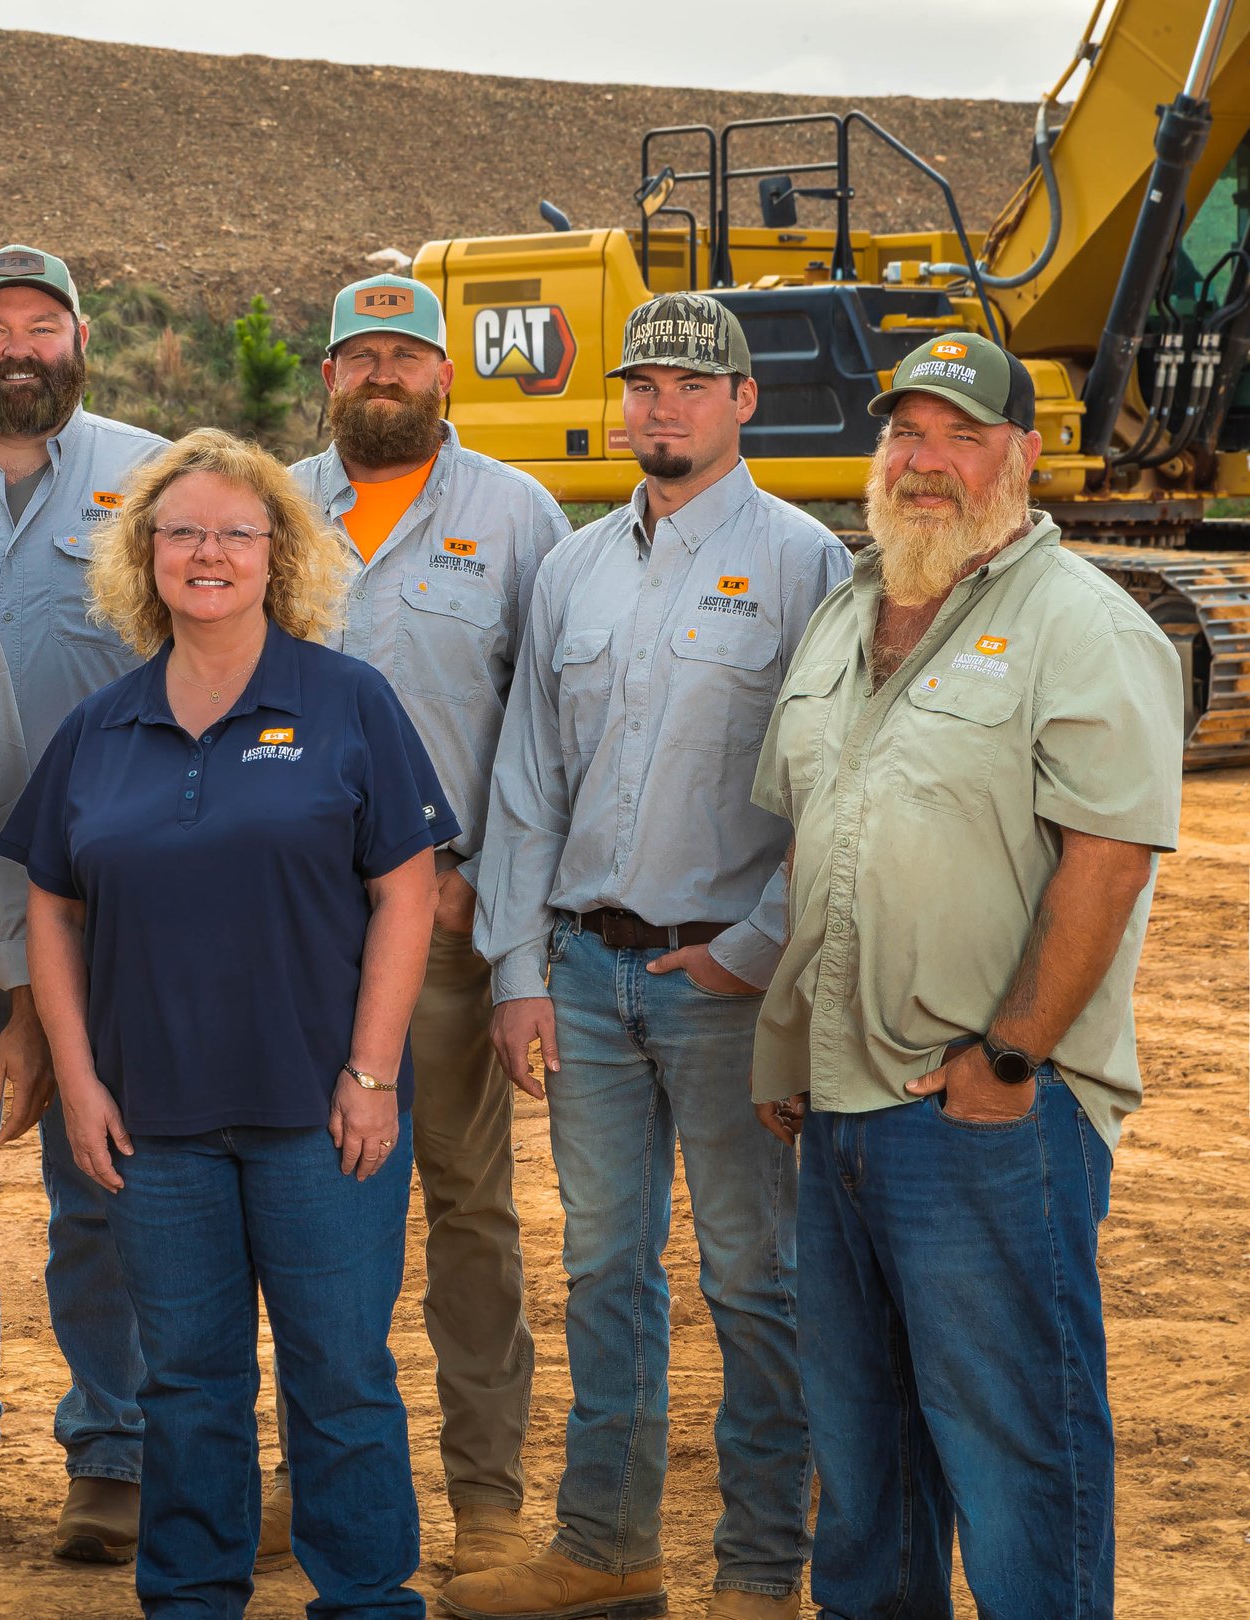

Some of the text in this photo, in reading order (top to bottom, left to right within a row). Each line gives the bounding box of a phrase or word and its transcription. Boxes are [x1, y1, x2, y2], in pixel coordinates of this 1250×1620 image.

[365, 294, 406, 306] LT
[632, 320, 715, 341] LASSITER TAYLOR
[475, 307, 551, 376] CAT
[631, 335, 716, 349] CONSTRUCTION
[935, 345, 962, 355] LT
[911, 361, 977, 379] LASSITER TAYLOR
[910, 370, 974, 385] CONSTRUCTION
[81, 508, 113, 519] LASSITER
[449, 542, 472, 552] LT
[429, 563, 484, 578] CONSTRUCTION
[430, 554, 486, 573] LASSITER TAYLOR
[721, 580, 745, 590] LT
[699, 595, 759, 613] LASSITER TAYLOR
[697, 605, 758, 618] CONSTRUCTION
[980, 640, 1003, 650] LT
[954, 652, 1009, 673] LASSITER TAYLOR
[951, 662, 1005, 679] CONSTRUCTION
[263, 732, 289, 741] LT
[242, 745, 304, 759] LASSITER TAYLOR
